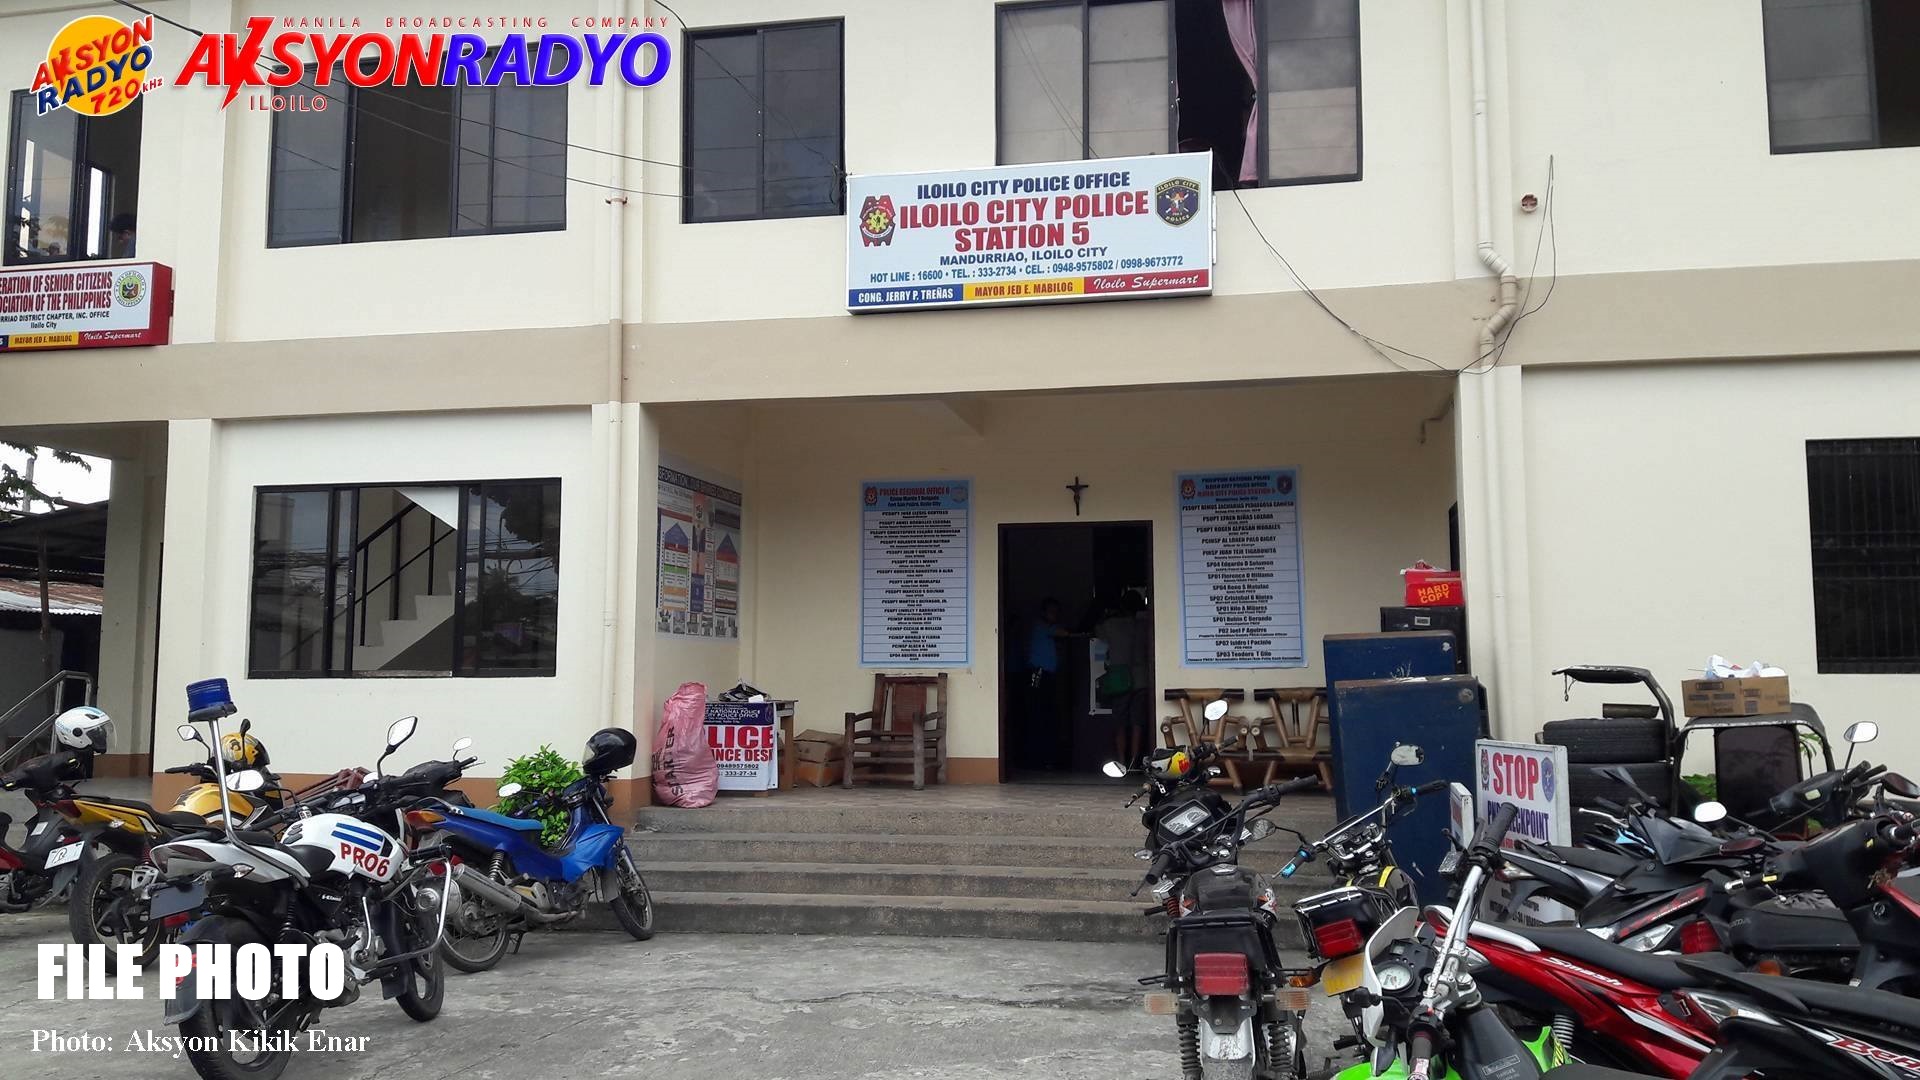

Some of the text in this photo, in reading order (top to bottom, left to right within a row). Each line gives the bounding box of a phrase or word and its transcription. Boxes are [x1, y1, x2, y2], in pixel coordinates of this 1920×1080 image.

[917, 171, 1130, 200] ILOILO CITY POLICE OFFICE
[900, 190, 1149, 229] ILOILO CITY POLICE
[954, 221, 1090, 252] STATION 5
[940, 246, 1108, 266] MANDURRIAO, ILOILO CITY
[870, 273, 888, 283] HOT
[890, 272, 910, 282] LINE
[917, 270, 943, 280] 16600
[951, 268, 971, 279] TEL.
[978, 265, 1017, 277] 333-2734
[1025, 264, 1045, 275] CEL.
[1052, 260, 1114, 273] 0948-9575802
[1121, 256, 1184, 269] 0998-9673772
[32, 275, 44, 294] OF
[44, 273, 75, 292] SENIOR
[76, 271, 113, 290] CITIZENS
[974, 282, 1073, 297] MAYOR JED E. MABILOG
[1093, 274, 1199, 290] Iloilo Supermart
[34, 294, 46, 312] OF
[46, 293, 62, 311] THE
[62, 290, 111, 310] PHILIPPINES
[858, 287, 954, 304] CONG. JERRY P. TREÑAS
[30, 321, 57, 330] Iloilo City
[46, 313, 74, 321] CHAPTER,
[14, 336, 33, 345] MAYOR
[33, 335, 42, 344] JED
[49, 334, 73, 343] MABILOG
[104, 331, 142, 341] Supermart
[1417, 584, 1449, 597] HARD
[1420, 591, 1450, 604] COPY
[1492, 751, 1539, 801] STOP
[340, 842, 390, 877] PRO6
[1542, 956, 1624, 985] Smash
